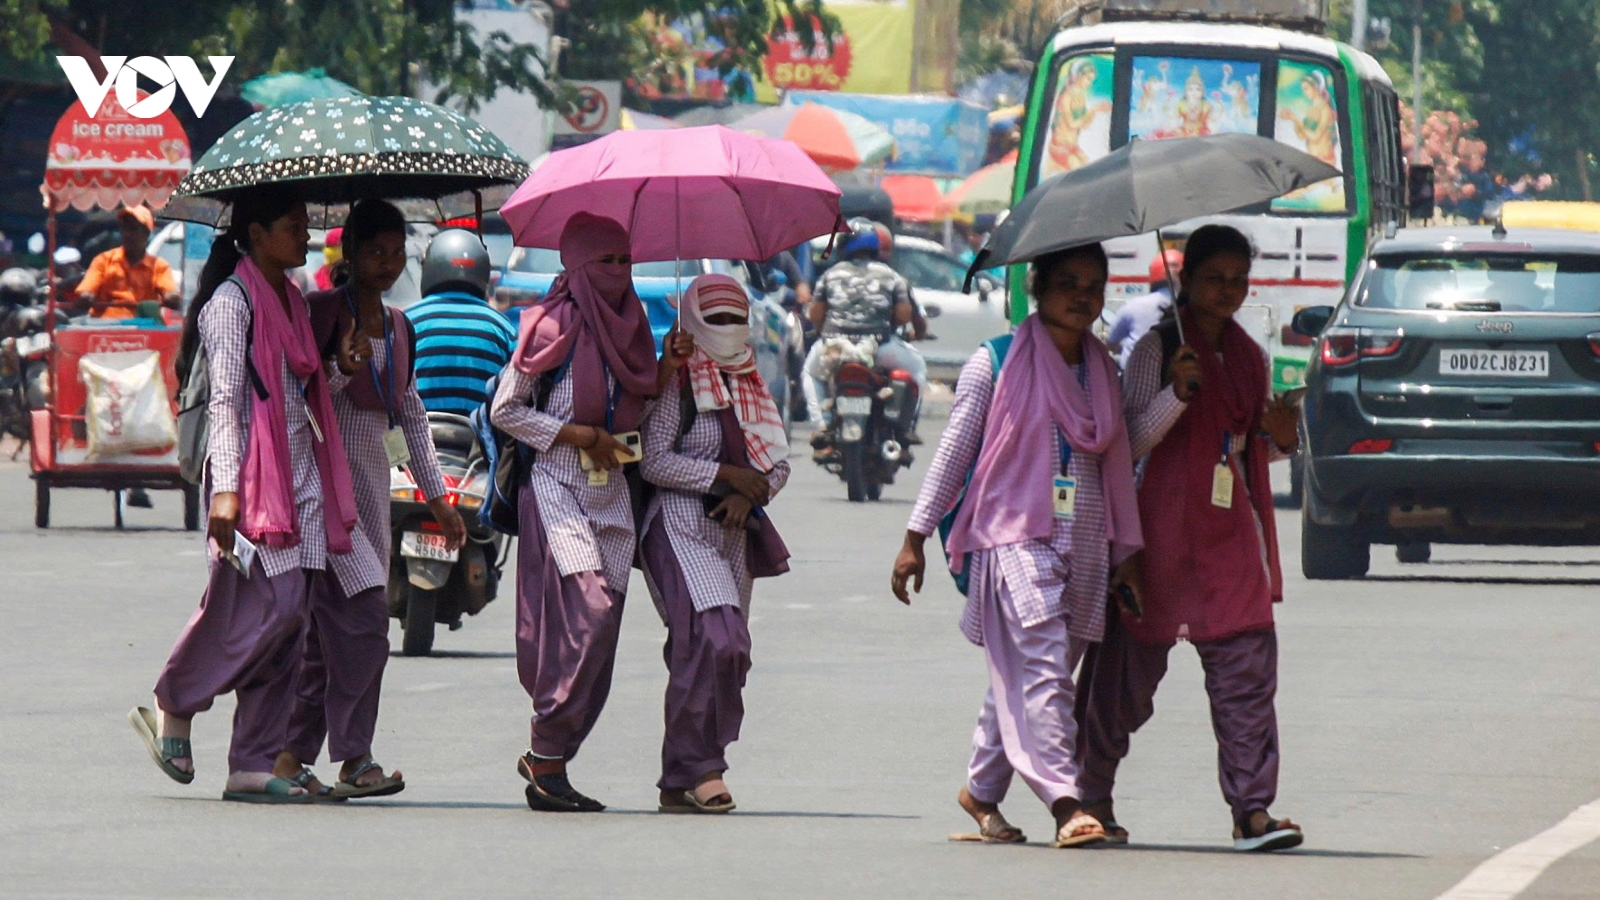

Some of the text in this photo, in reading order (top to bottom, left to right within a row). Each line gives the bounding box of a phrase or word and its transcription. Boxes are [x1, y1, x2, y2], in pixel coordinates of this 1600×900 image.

[775, 62, 840, 85] 50%
[73, 120, 164, 136] ice cream
[1476, 319, 1514, 333] Jeep
[1450, 354, 1546, 371] OD02CJ8231
